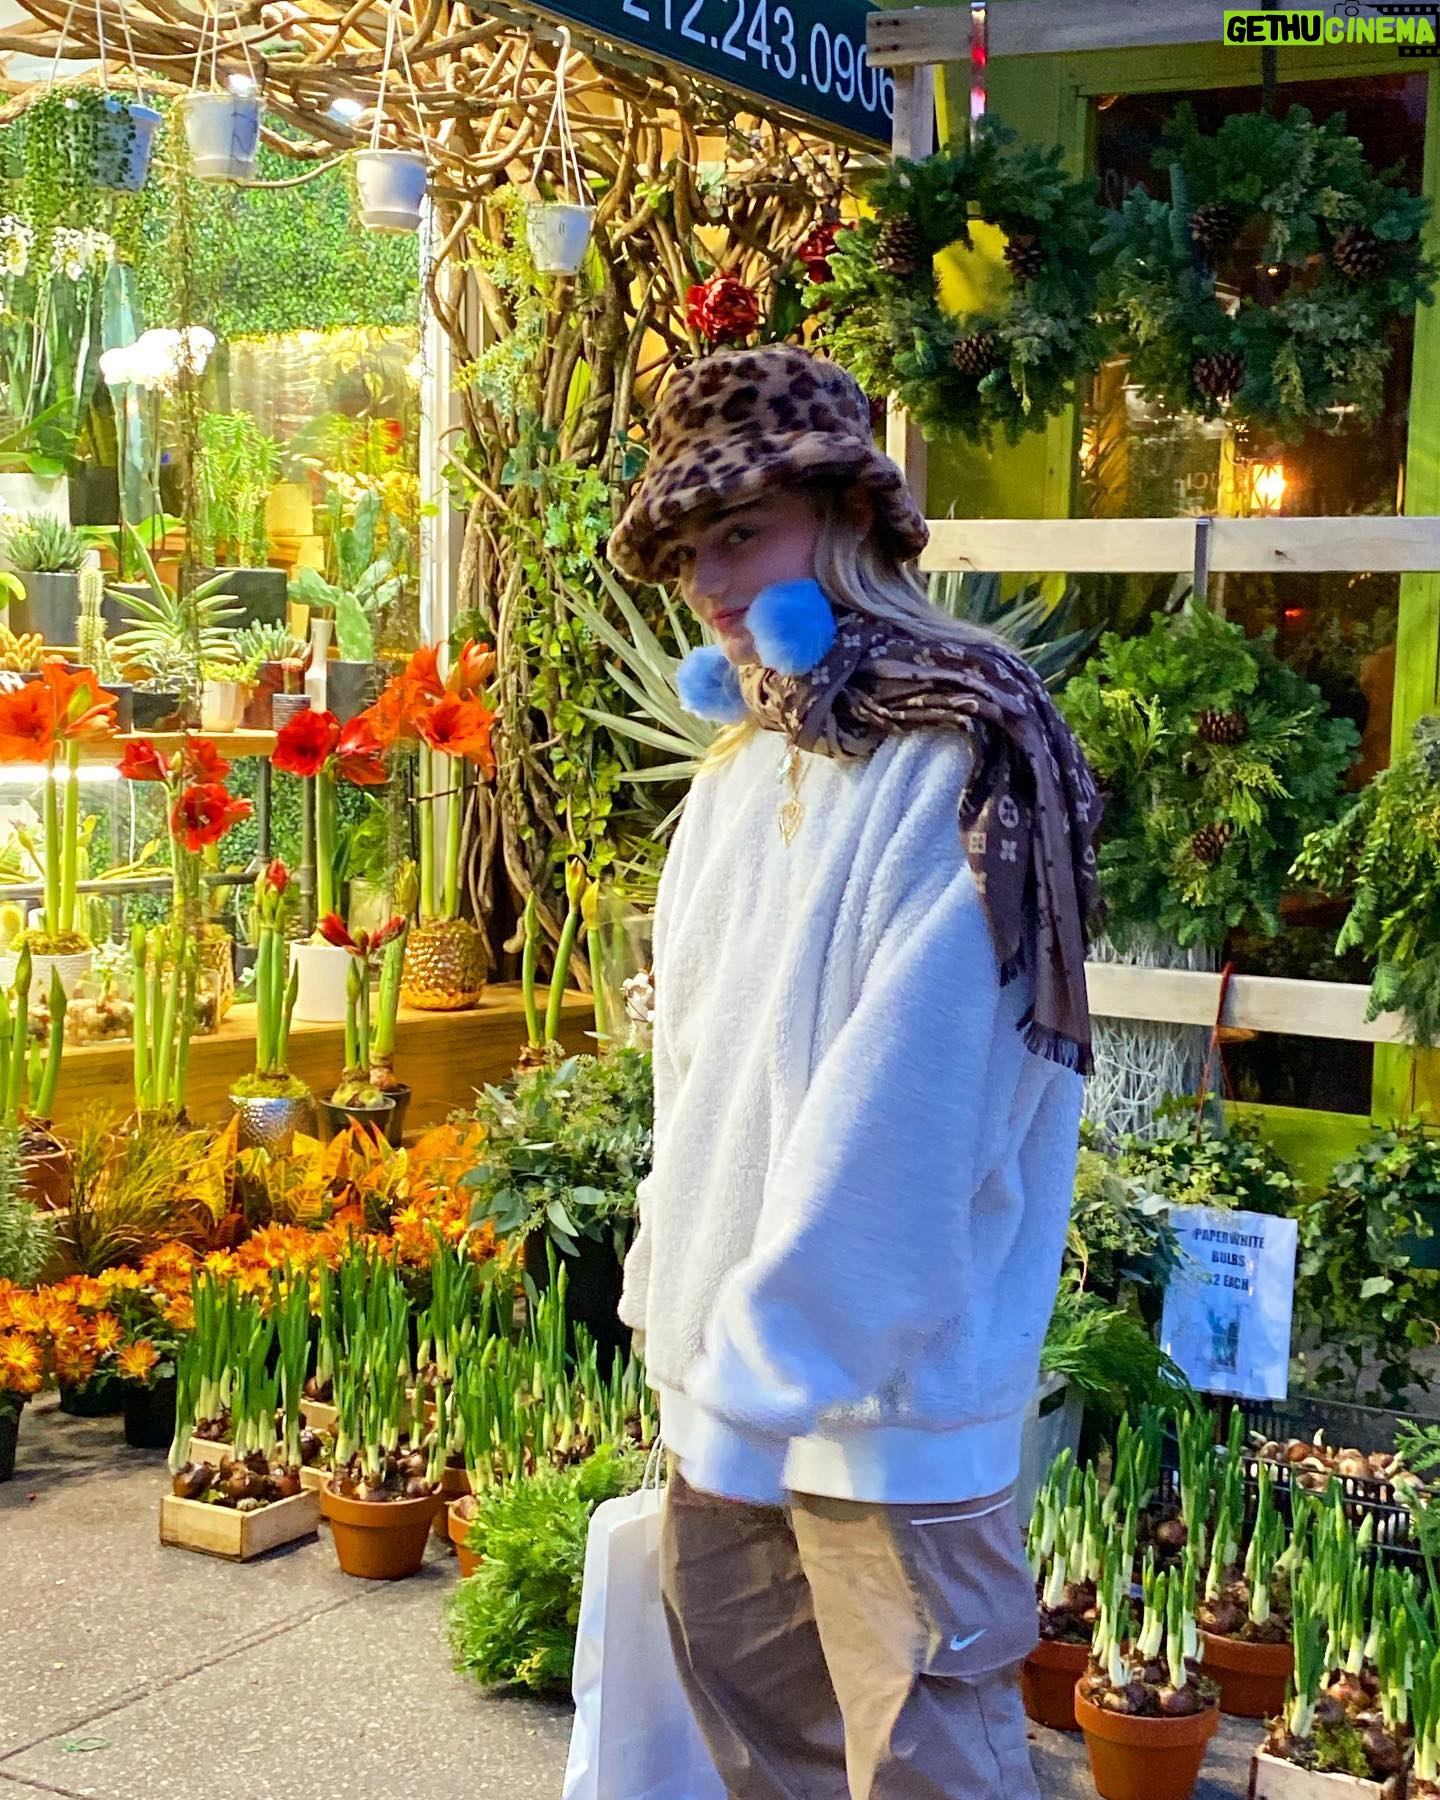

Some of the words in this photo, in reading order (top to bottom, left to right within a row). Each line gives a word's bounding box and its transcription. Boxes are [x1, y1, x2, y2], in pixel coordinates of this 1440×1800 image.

[1193, 1227, 1265, 1249] PAPERWHITE
[1211, 1249, 1246, 1267] BULBS
[1223, 1274, 1249, 1291] EACH
